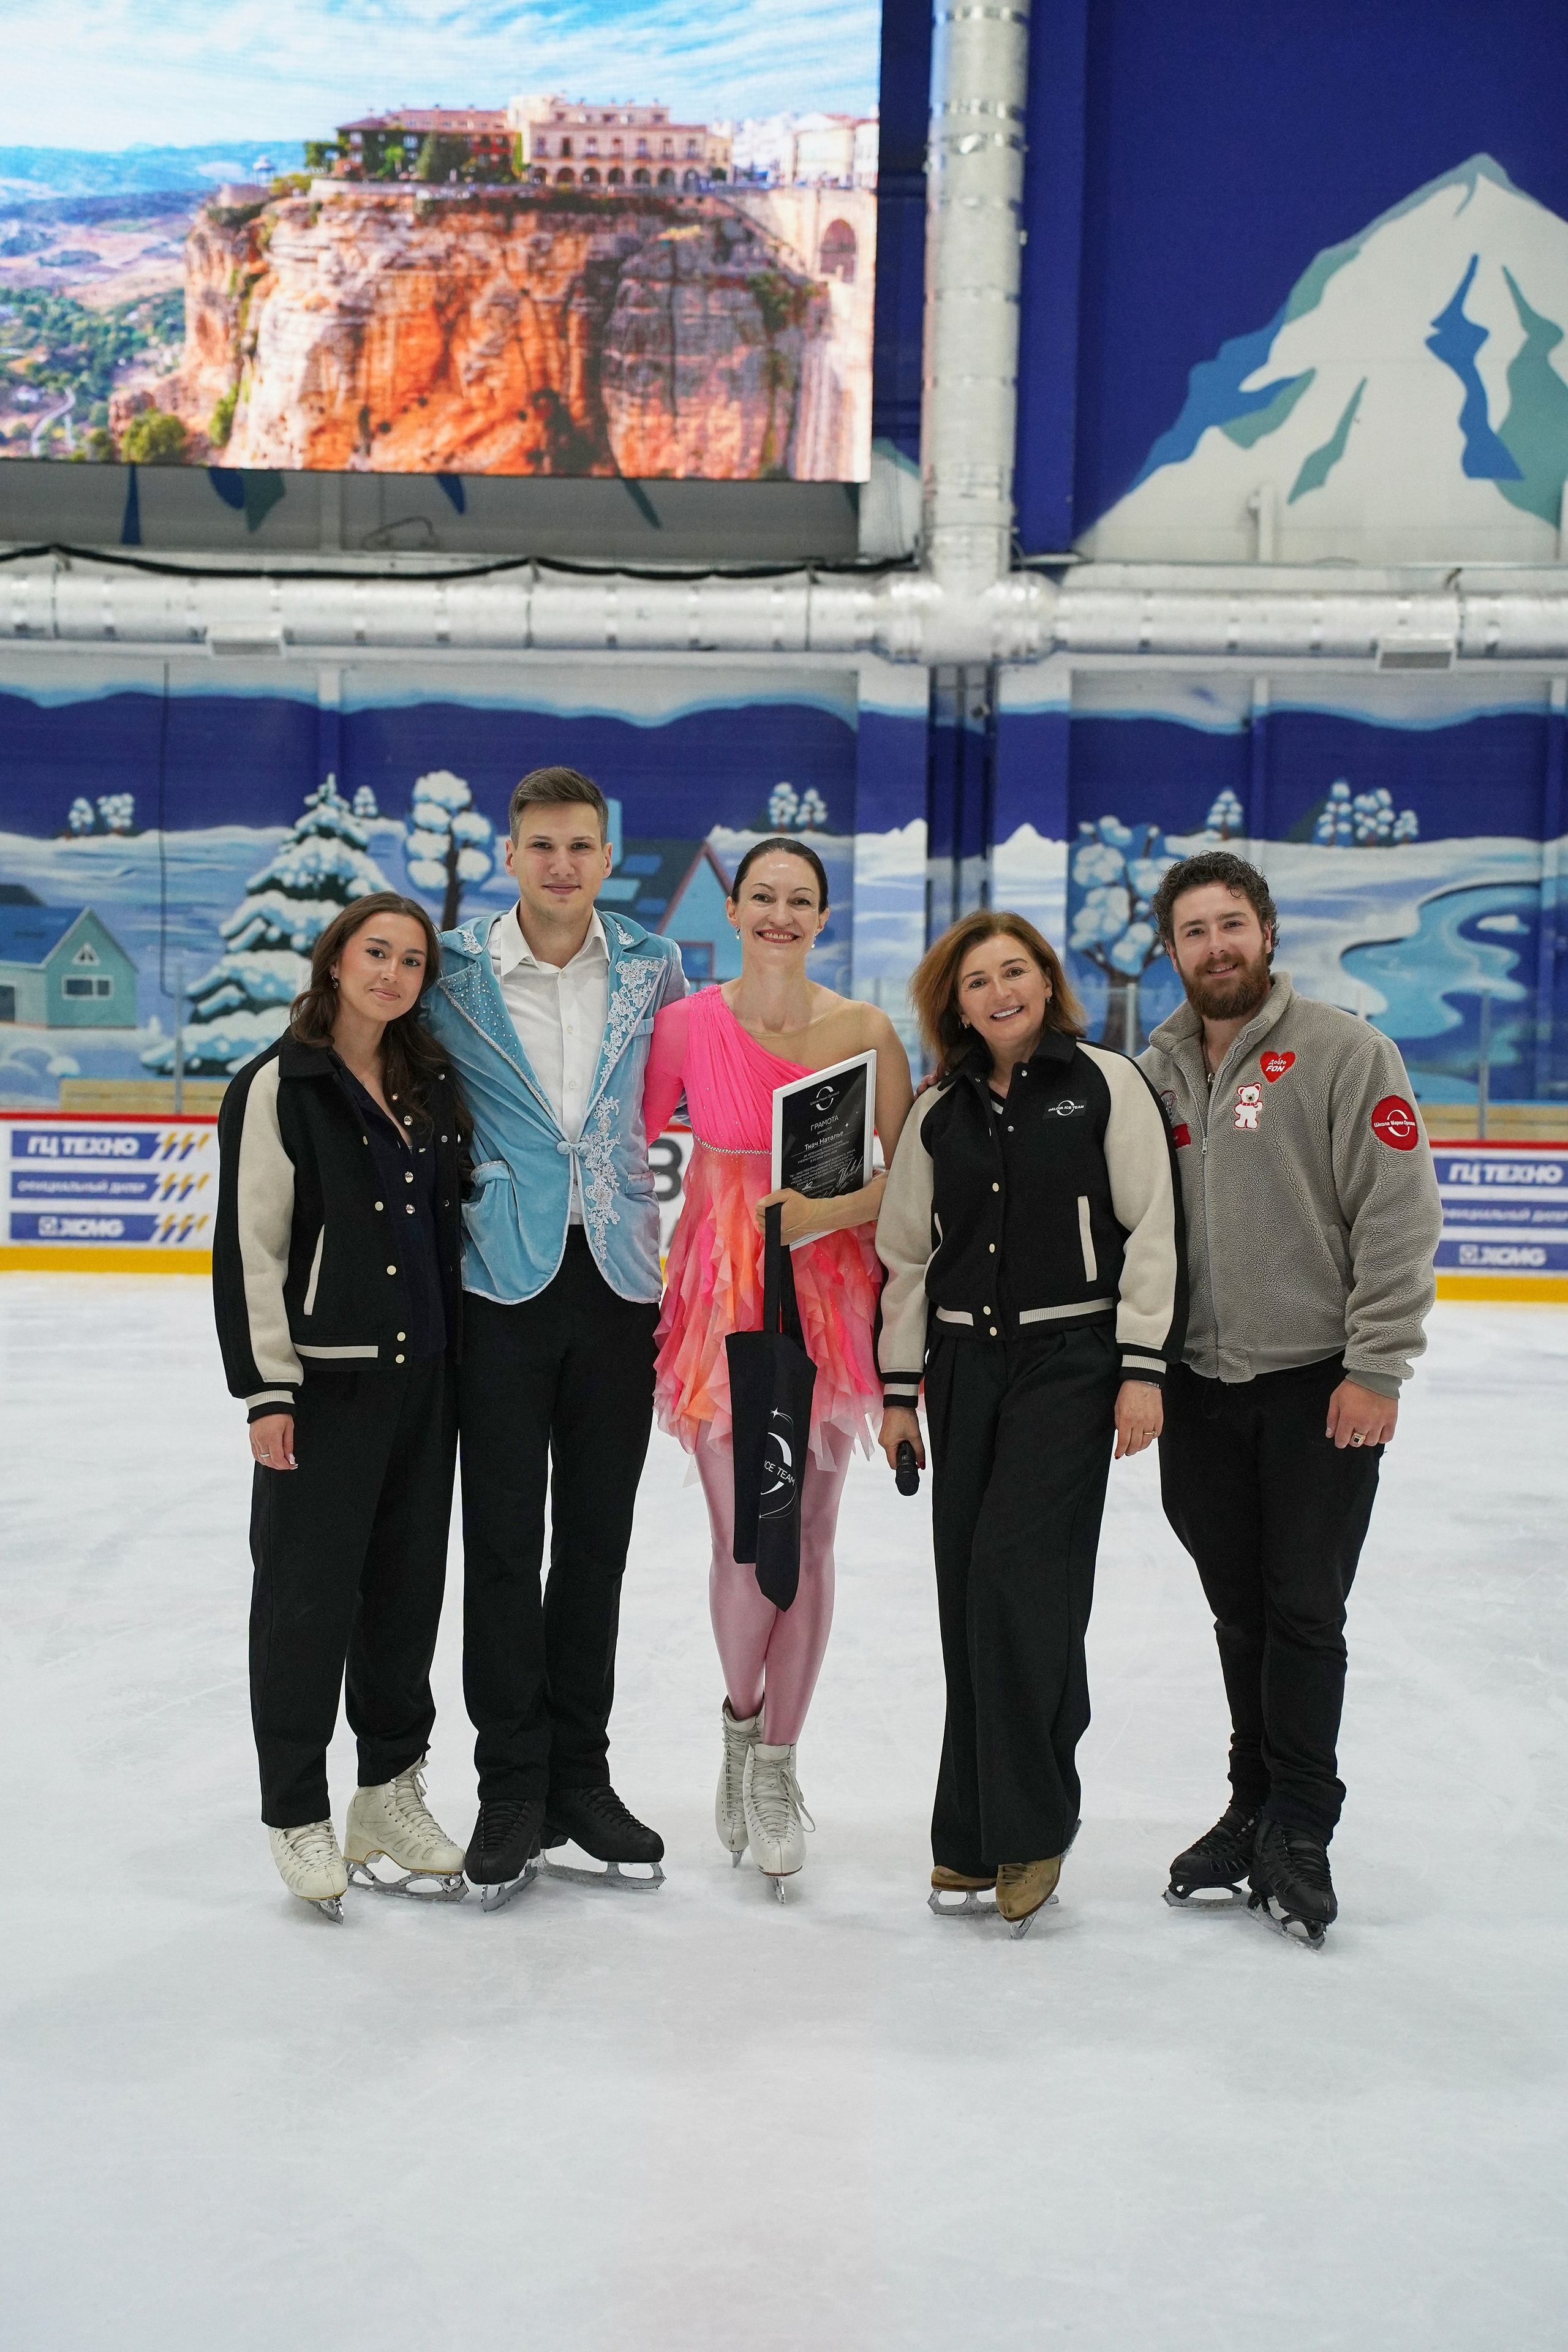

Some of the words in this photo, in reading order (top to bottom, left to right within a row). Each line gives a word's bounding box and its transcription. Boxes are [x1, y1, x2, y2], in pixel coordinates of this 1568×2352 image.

[1268, 1057, 1287, 1066] Добро
[810, 1115, 839, 1131] ГРАМОТА
[62, 1136, 140, 1156] ТЕХНО
[804, 1141, 818, 1150] Ткач
[820, 1131, 844, 1145] Наталье
[763, 1460, 776, 1473] ICE
[777, 1466, 795, 1487] TEAM
